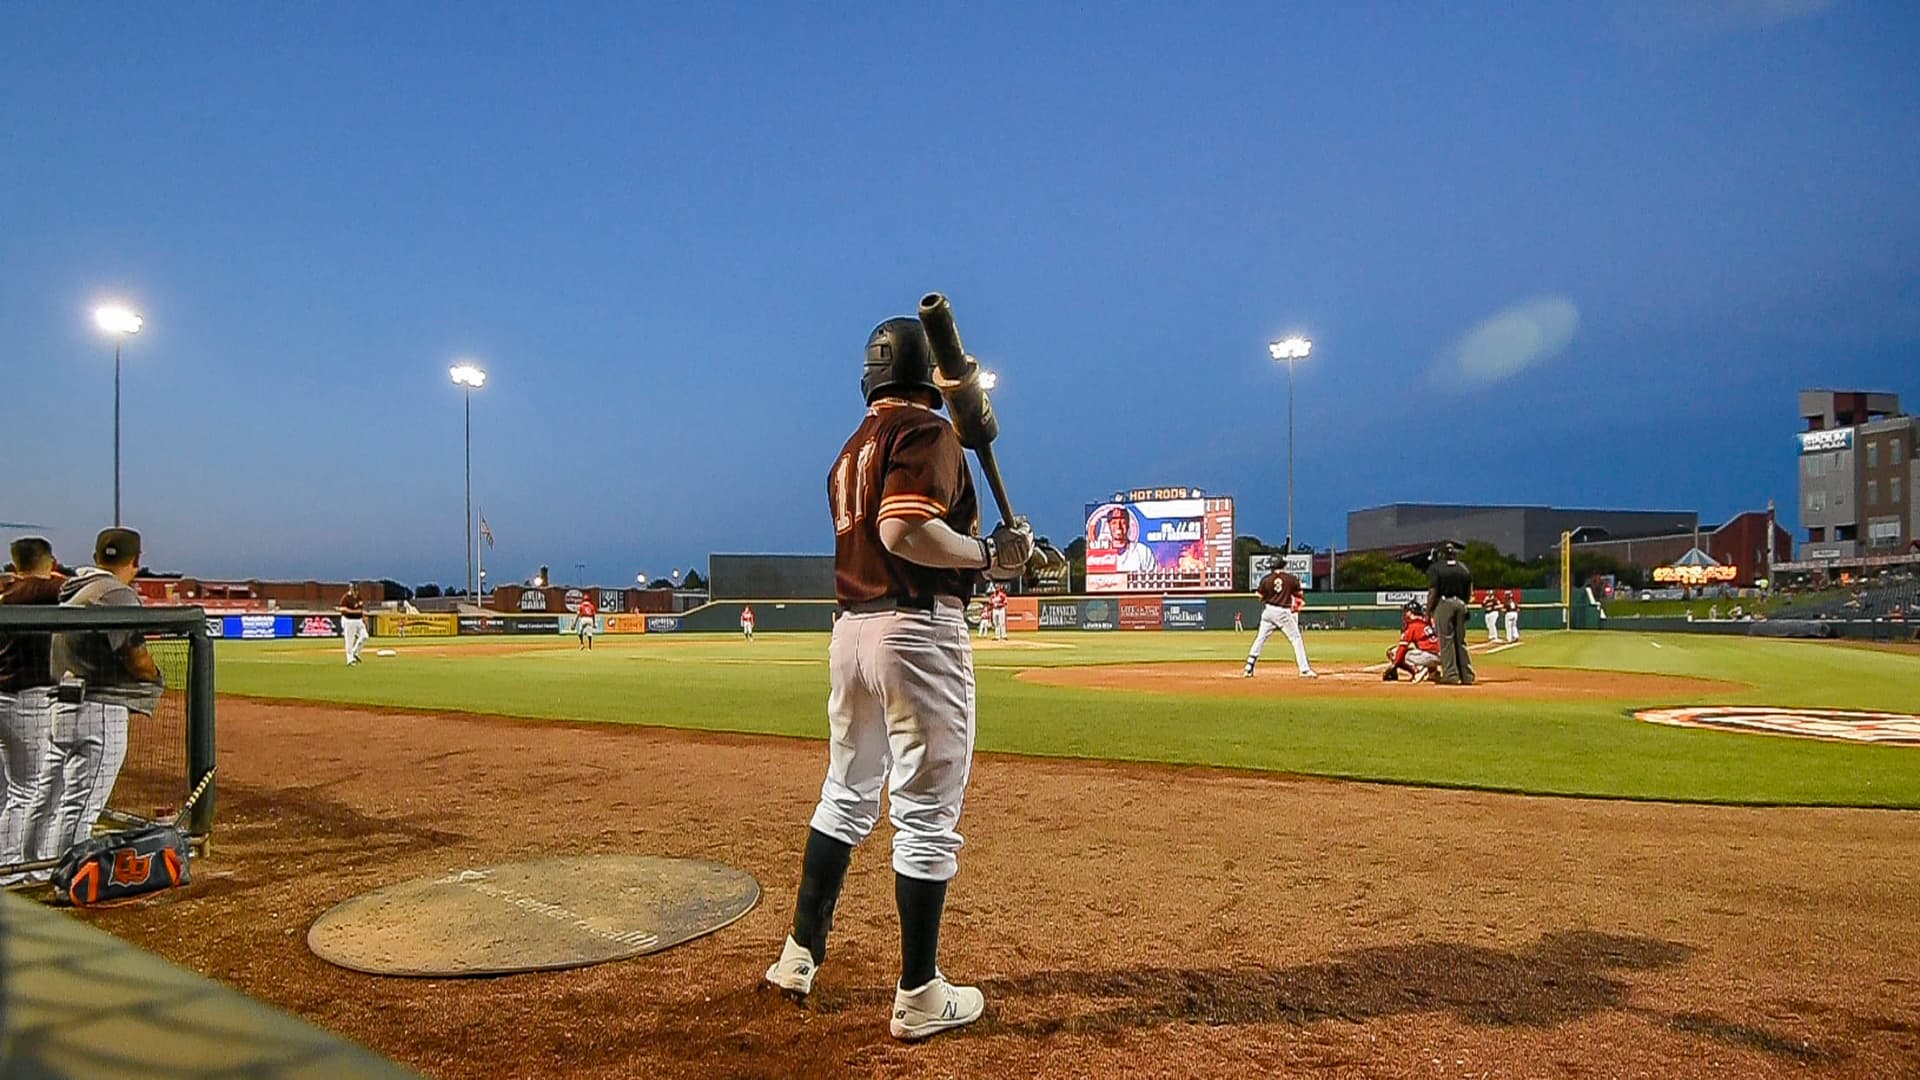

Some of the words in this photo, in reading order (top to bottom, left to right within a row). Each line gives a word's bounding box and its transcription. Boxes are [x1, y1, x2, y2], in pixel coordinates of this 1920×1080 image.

[1129, 490, 1152, 500] HOT
[1155, 488, 1187, 499] RODS
[940, 1001, 957, 1019] N
